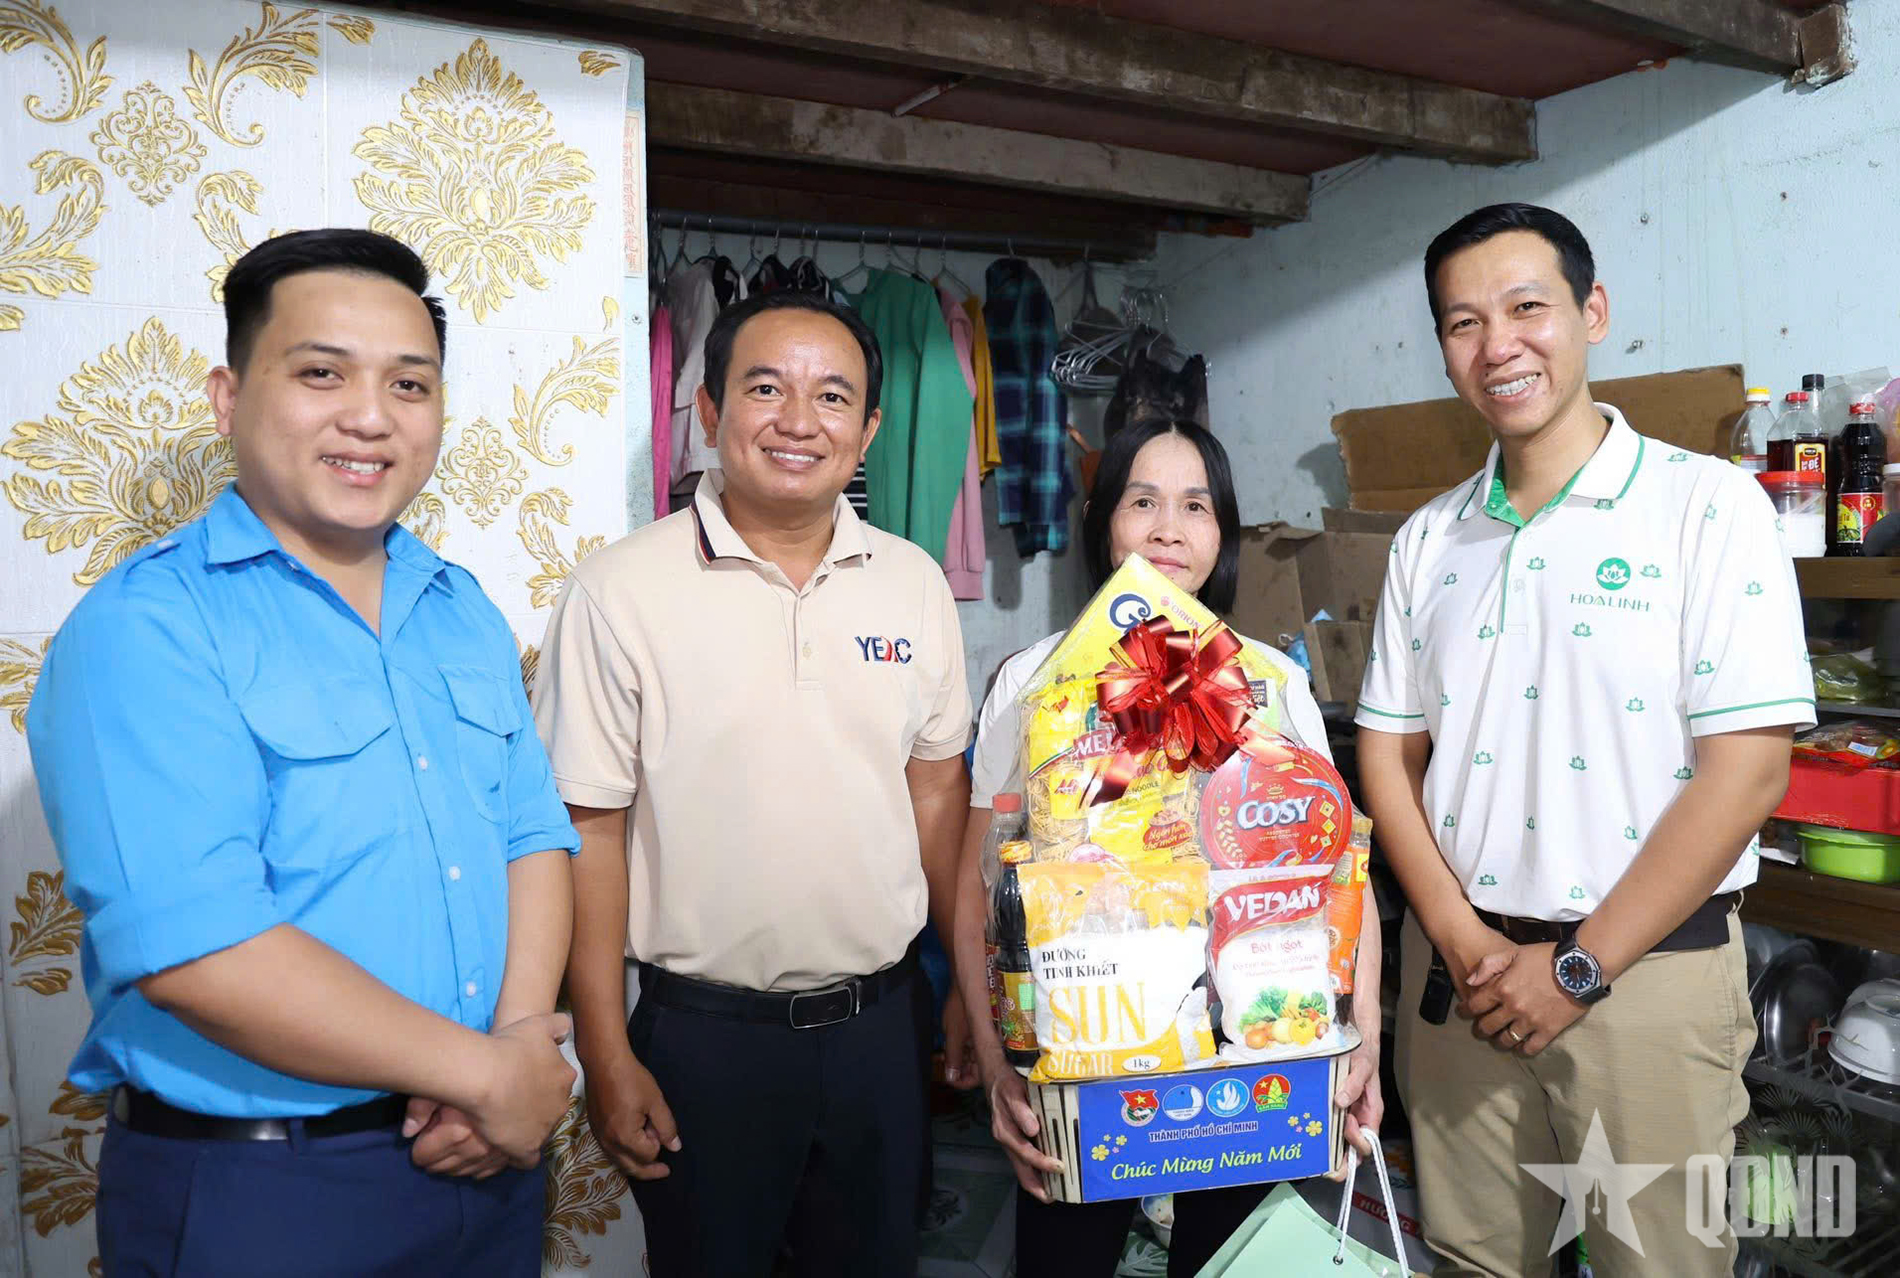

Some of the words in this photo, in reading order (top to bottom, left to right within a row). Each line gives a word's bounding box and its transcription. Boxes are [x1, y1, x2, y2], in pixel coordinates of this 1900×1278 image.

[1237, 796, 1316, 830] COSY
[1224, 882, 1320, 920] VEDAN
[1042, 947, 1086, 963] ĐƯỜNG
[1043, 966, 1073, 980] TINH
[1049, 982, 1146, 1044] SUN
[1047, 1050, 1114, 1075] SUGAR
[1132, 1057, 1151, 1070] 1kg
[1149, 1129, 1180, 1142] THÀNH
[1181, 1125, 1200, 1139] PHỐ
[1200, 1123, 1214, 1137] HỒ
[1216, 1121, 1233, 1135] CHÍ
[1234, 1121, 1259, 1133] MINH
[1111, 1162, 1157, 1180] Chúc
[1161, 1157, 1214, 1174] Mừng
[1219, 1151, 1263, 1169] Năm
[1267, 1143, 1302, 1162] Mới
